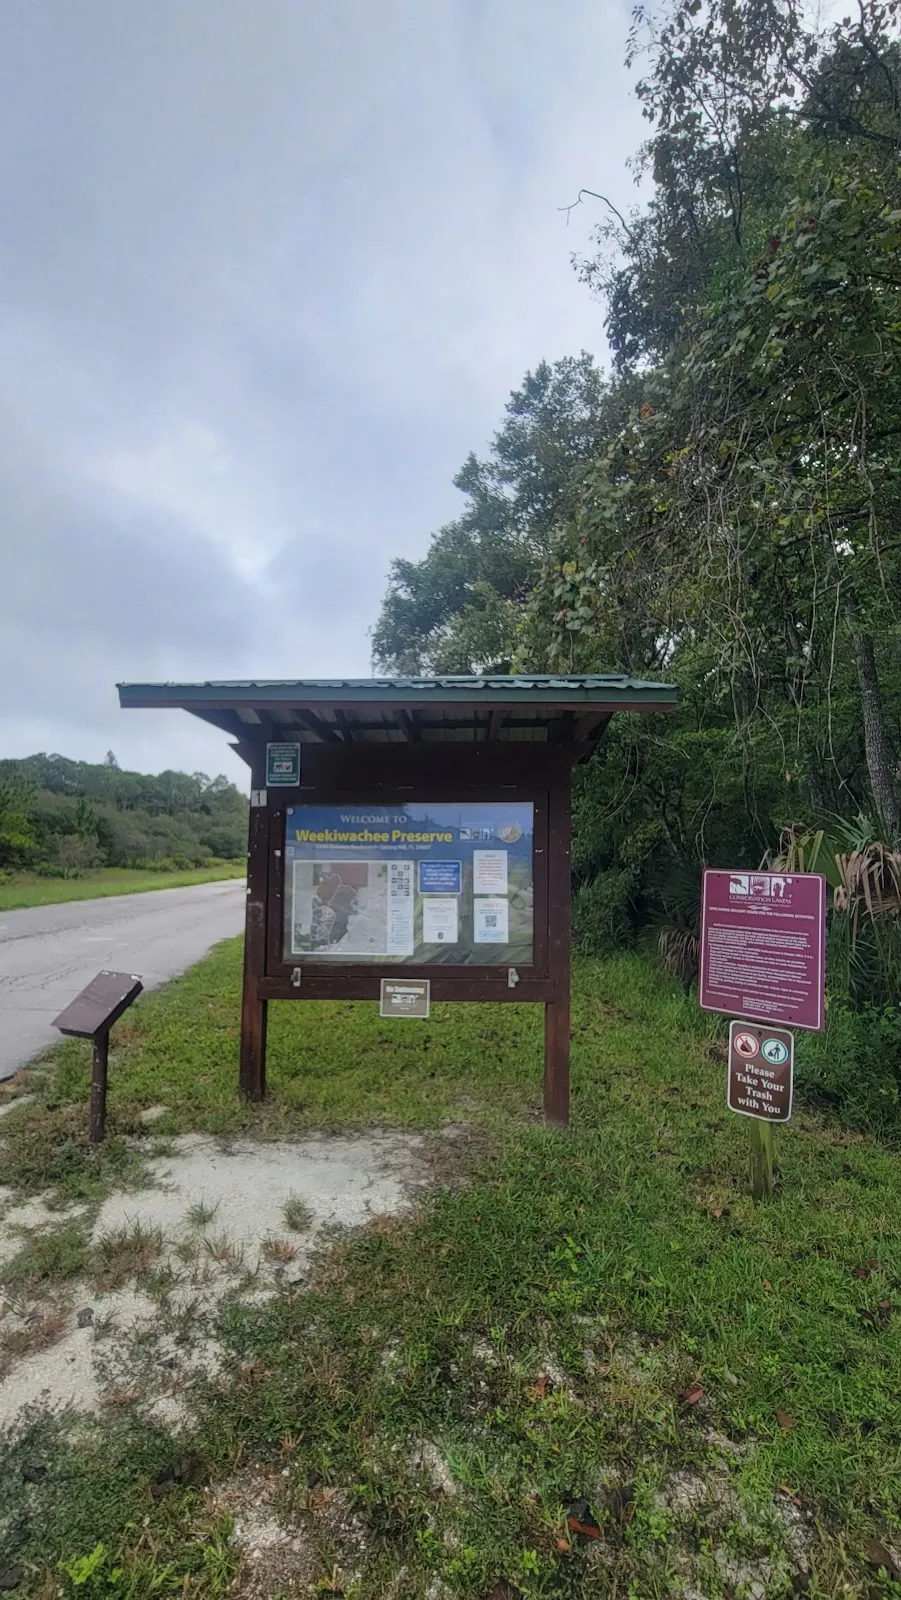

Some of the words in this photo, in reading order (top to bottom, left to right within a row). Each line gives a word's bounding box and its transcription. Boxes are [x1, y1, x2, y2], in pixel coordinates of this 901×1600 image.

[340, 814, 390, 824] WELCOME
[391, 815, 408, 824] TO
[295, 829, 389, 842] Weekiwachee
[391, 829, 453, 842] Preserve
[729, 895, 771, 903] CONSERVATION
[745, 1063, 775, 1078] Please
[735, 1072, 758, 1085] Take
[761, 1079, 785, 1092] Your
[745, 1086, 773, 1101] Trash
[737, 1097, 759, 1109] with
[762, 1102, 781, 1114] You
